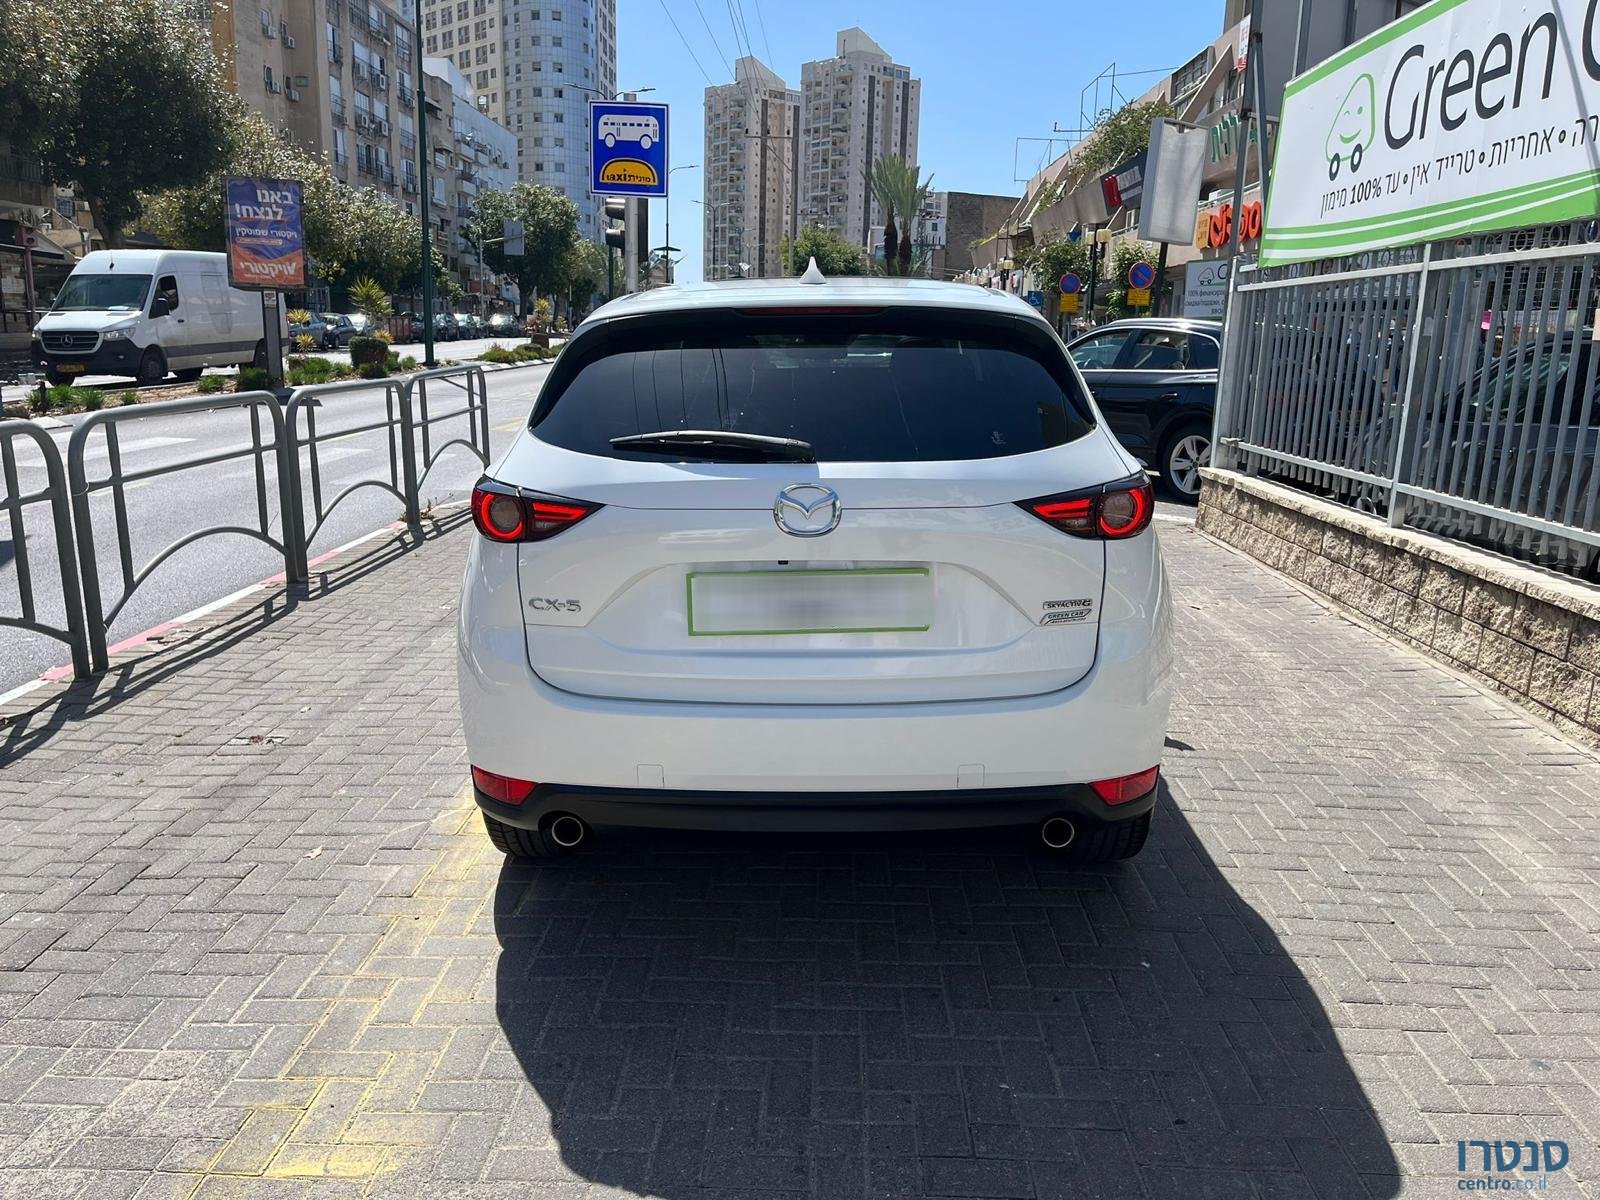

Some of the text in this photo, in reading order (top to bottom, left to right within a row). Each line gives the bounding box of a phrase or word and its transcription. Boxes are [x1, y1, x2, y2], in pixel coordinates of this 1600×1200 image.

[1384, 12, 1558, 150] Green
[1488, 126, 1555, 168] אחריות
[1410, 161, 1431, 195] אין
[1436, 149, 1475, 180] טרייד
[256, 189, 293, 204] באנו
[1350, 177, 1382, 205] 100%
[1385, 171, 1401, 194] עד
[235, 203, 283, 219] לנצח!
[1320, 188, 1348, 219] מימון
[528, 597, 582, 612] CX-5
